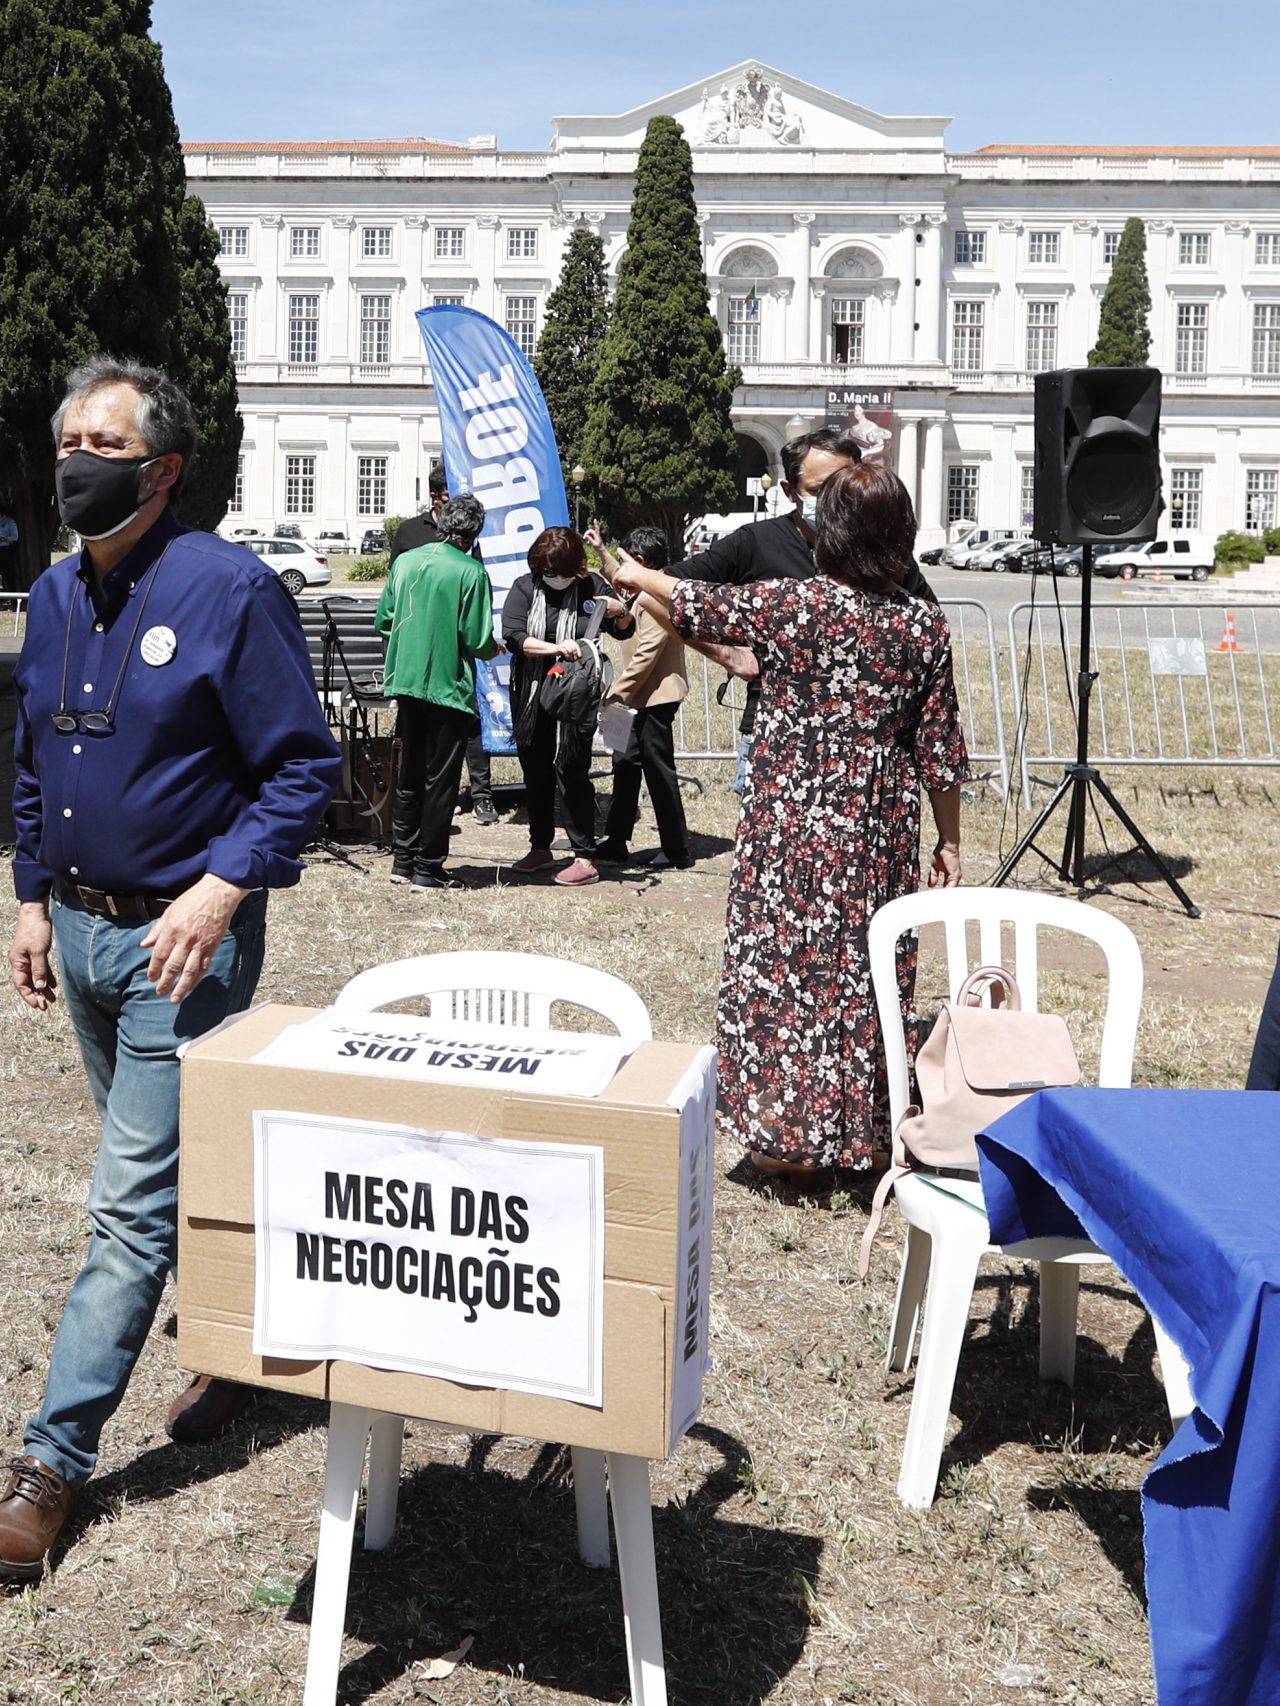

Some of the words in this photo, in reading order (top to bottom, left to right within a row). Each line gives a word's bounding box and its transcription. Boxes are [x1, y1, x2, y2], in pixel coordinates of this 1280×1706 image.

[828, 391, 841, 403] D.
[843, 391, 880, 404] Maria
[883, 392, 892, 404] II
[336, 1040, 418, 1063] DAS
[426, 1050, 543, 1075] MESA
[324, 1171, 434, 1232] MESA
[450, 1186, 530, 1244] DAS
[296, 1232, 561, 1323] NEGOCIAÇÕES
[683, 1235, 701, 1364] MESA
